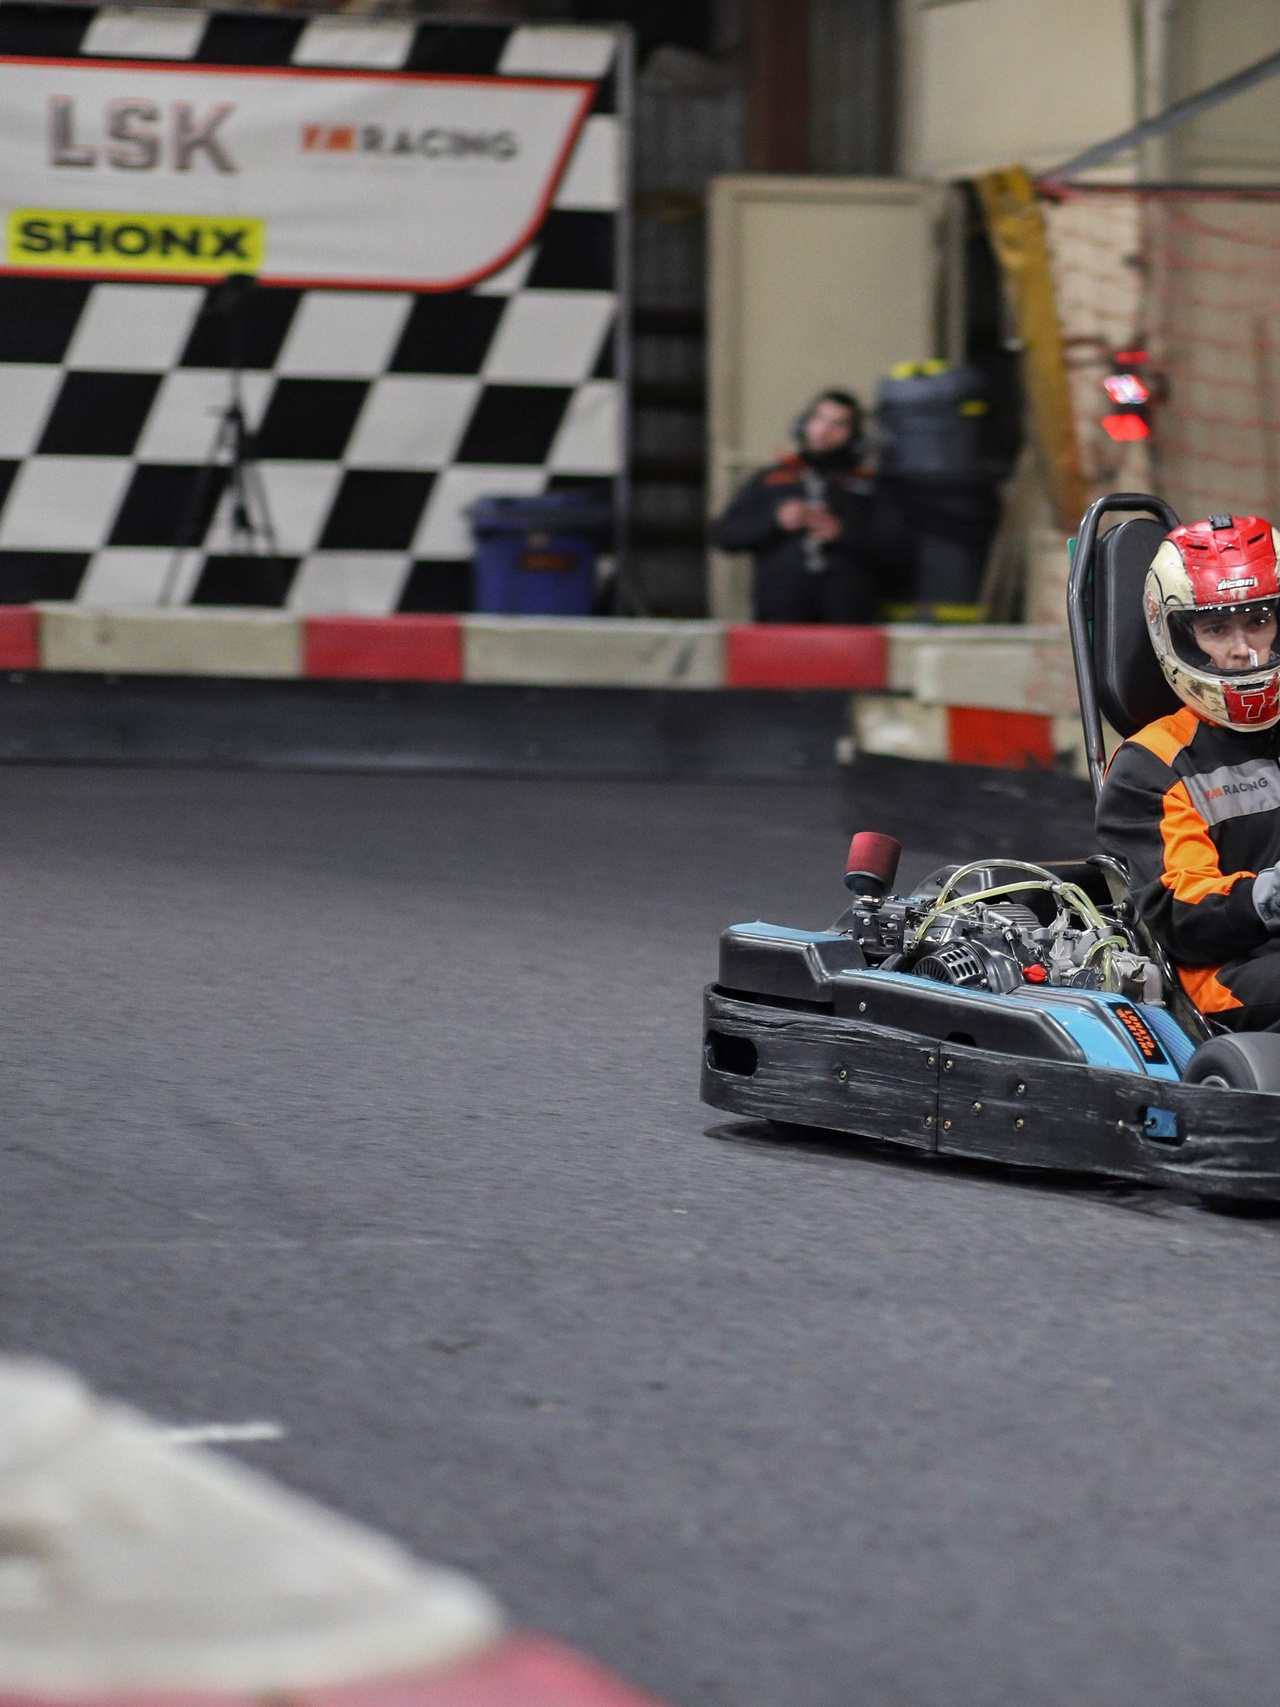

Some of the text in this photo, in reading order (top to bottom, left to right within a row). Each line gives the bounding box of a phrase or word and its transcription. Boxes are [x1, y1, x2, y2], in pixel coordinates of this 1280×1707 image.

[49, 95, 239, 174] LSK
[19, 219, 248, 259] SHONX
[1241, 692, 1266, 719] 7
